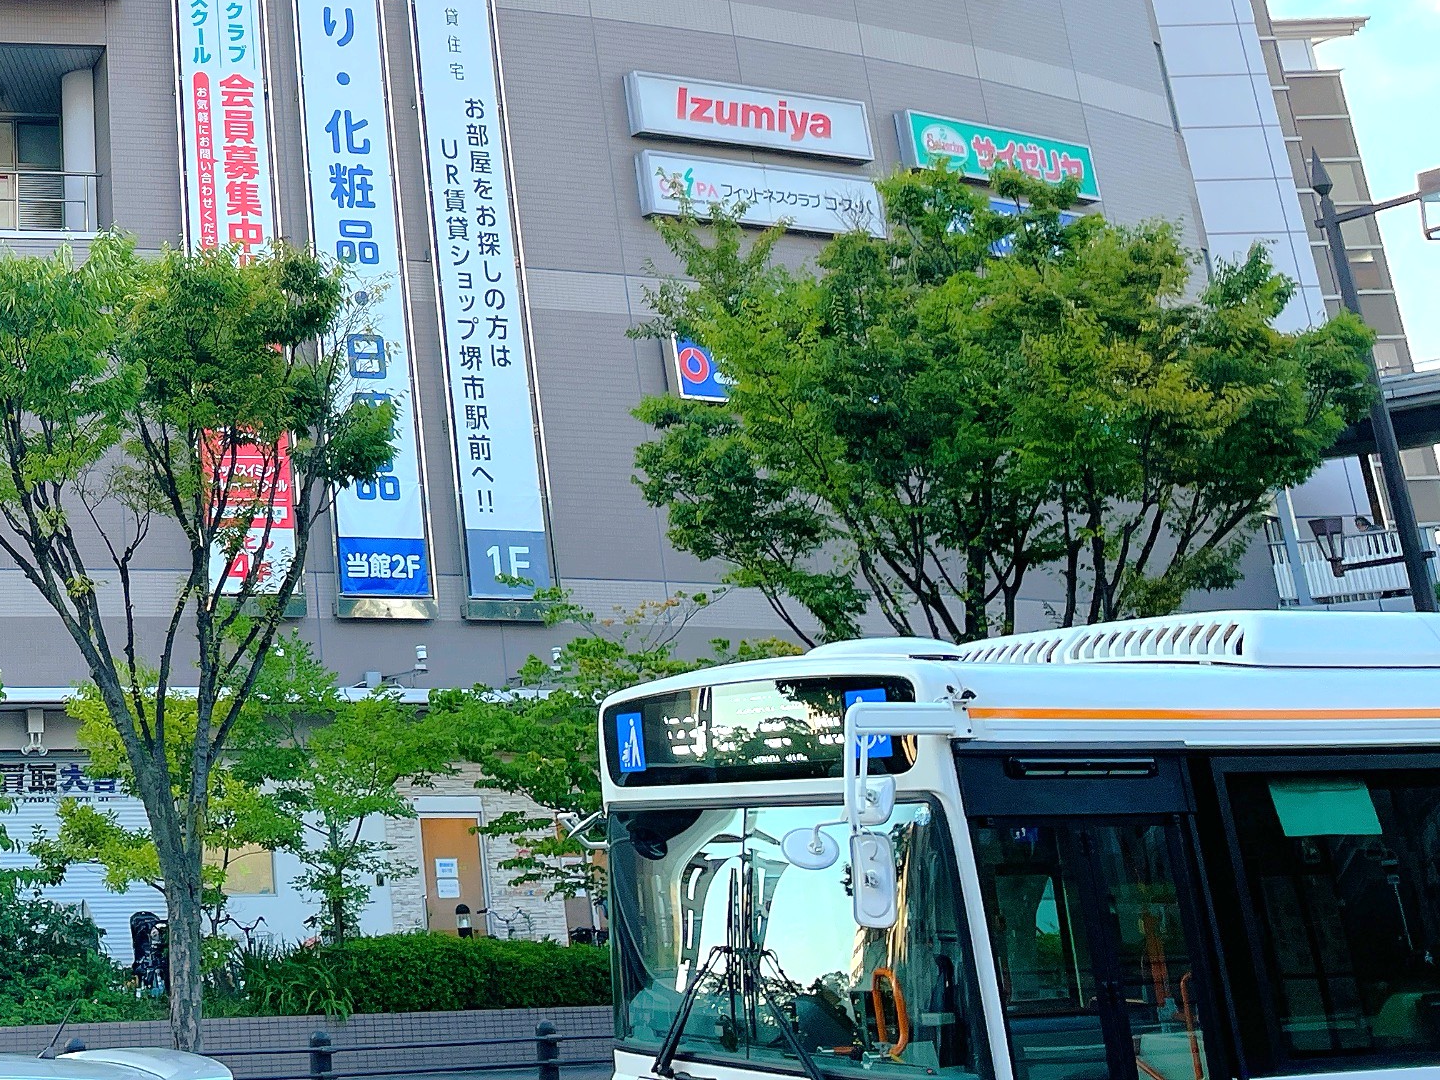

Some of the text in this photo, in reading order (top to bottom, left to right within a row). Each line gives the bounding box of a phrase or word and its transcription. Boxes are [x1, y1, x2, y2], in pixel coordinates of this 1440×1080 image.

[676, 86, 832, 142] Izumiya
[196, 87, 216, 256] お気軽にお問い合わせくださ
[972, 134, 1083, 183] サイゼリヤ
[720, 183, 821, 208] フィットネスクラブ
[464, 98, 512, 368] お部屋をお探しの方は
[347, 552, 421, 580] 当館2F
[486, 544, 530, 579] 1F
